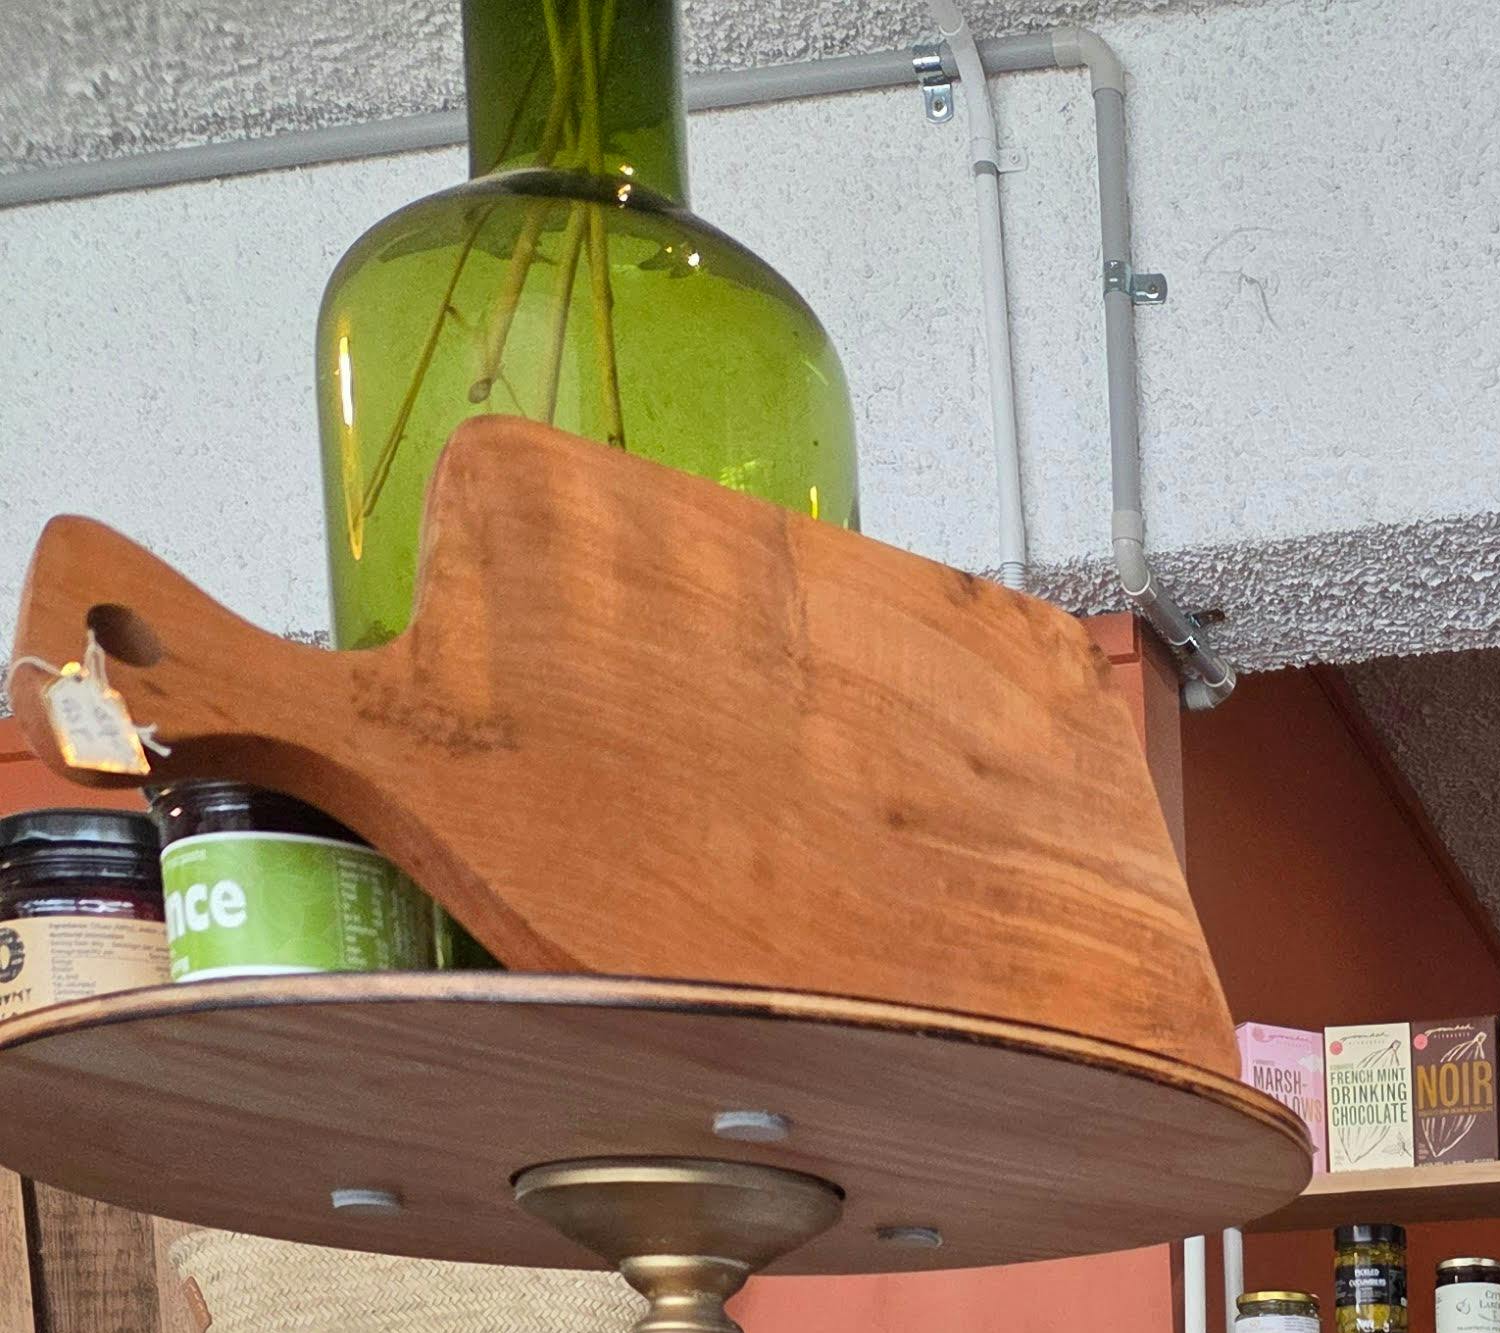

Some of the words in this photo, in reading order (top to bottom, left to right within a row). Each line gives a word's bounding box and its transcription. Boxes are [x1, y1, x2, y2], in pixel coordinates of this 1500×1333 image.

[1330, 1069, 1375, 1086] FRENCH
[1376, 1066, 1407, 1083] MINT
[1416, 1059, 1494, 1109] NOIR
[1330, 1082, 1408, 1106] DRINKING
[1331, 1103, 1408, 1128] CHOCOLATE
